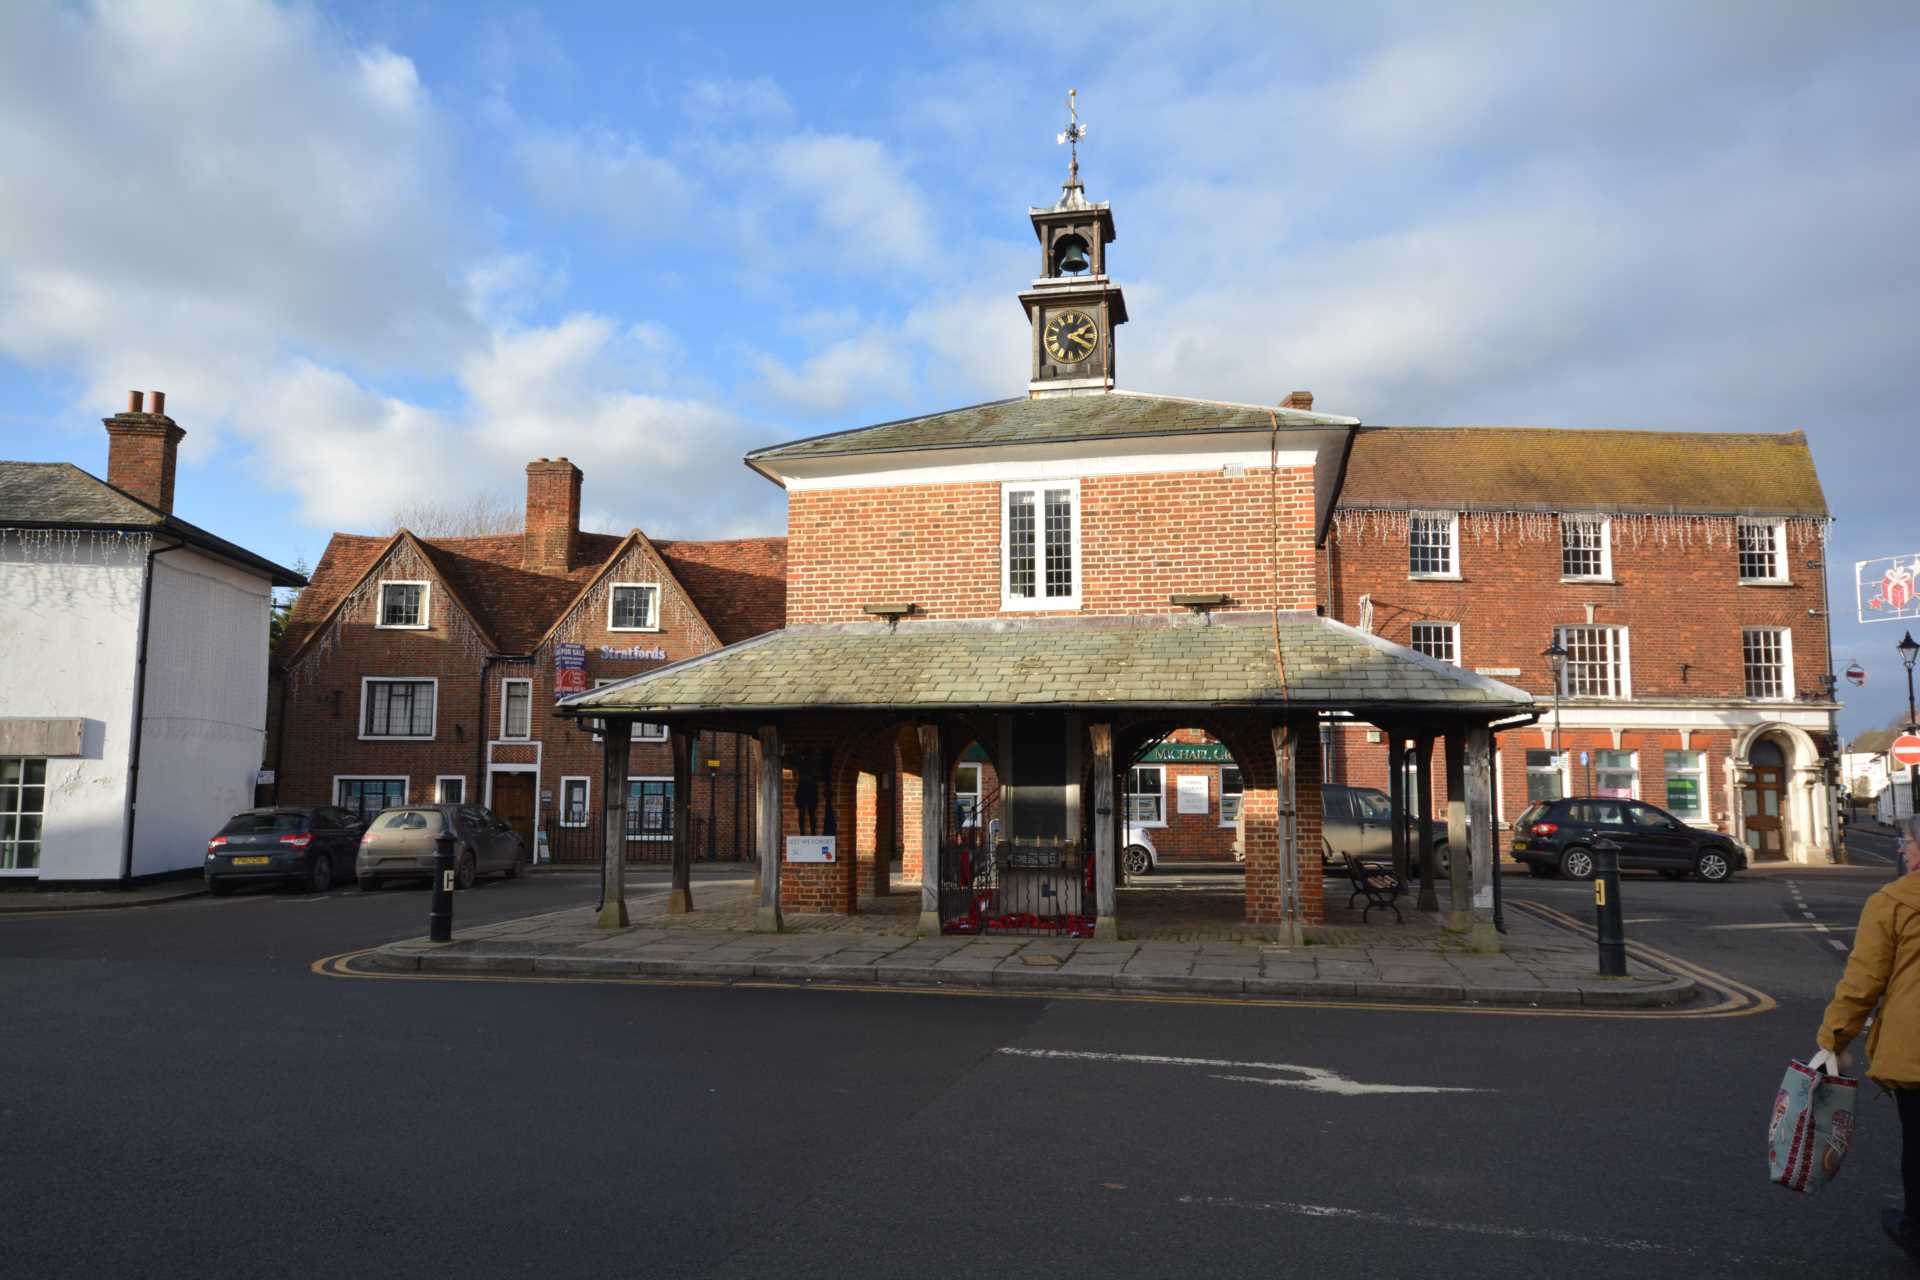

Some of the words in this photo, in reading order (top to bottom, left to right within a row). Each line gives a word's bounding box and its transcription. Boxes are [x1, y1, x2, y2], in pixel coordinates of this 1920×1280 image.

[561, 648, 572, 656] FOR
[573, 648, 585, 657] SALE
[601, 645, 666, 660] Stratfords
[1156, 749, 1212, 760] MICHAEL
